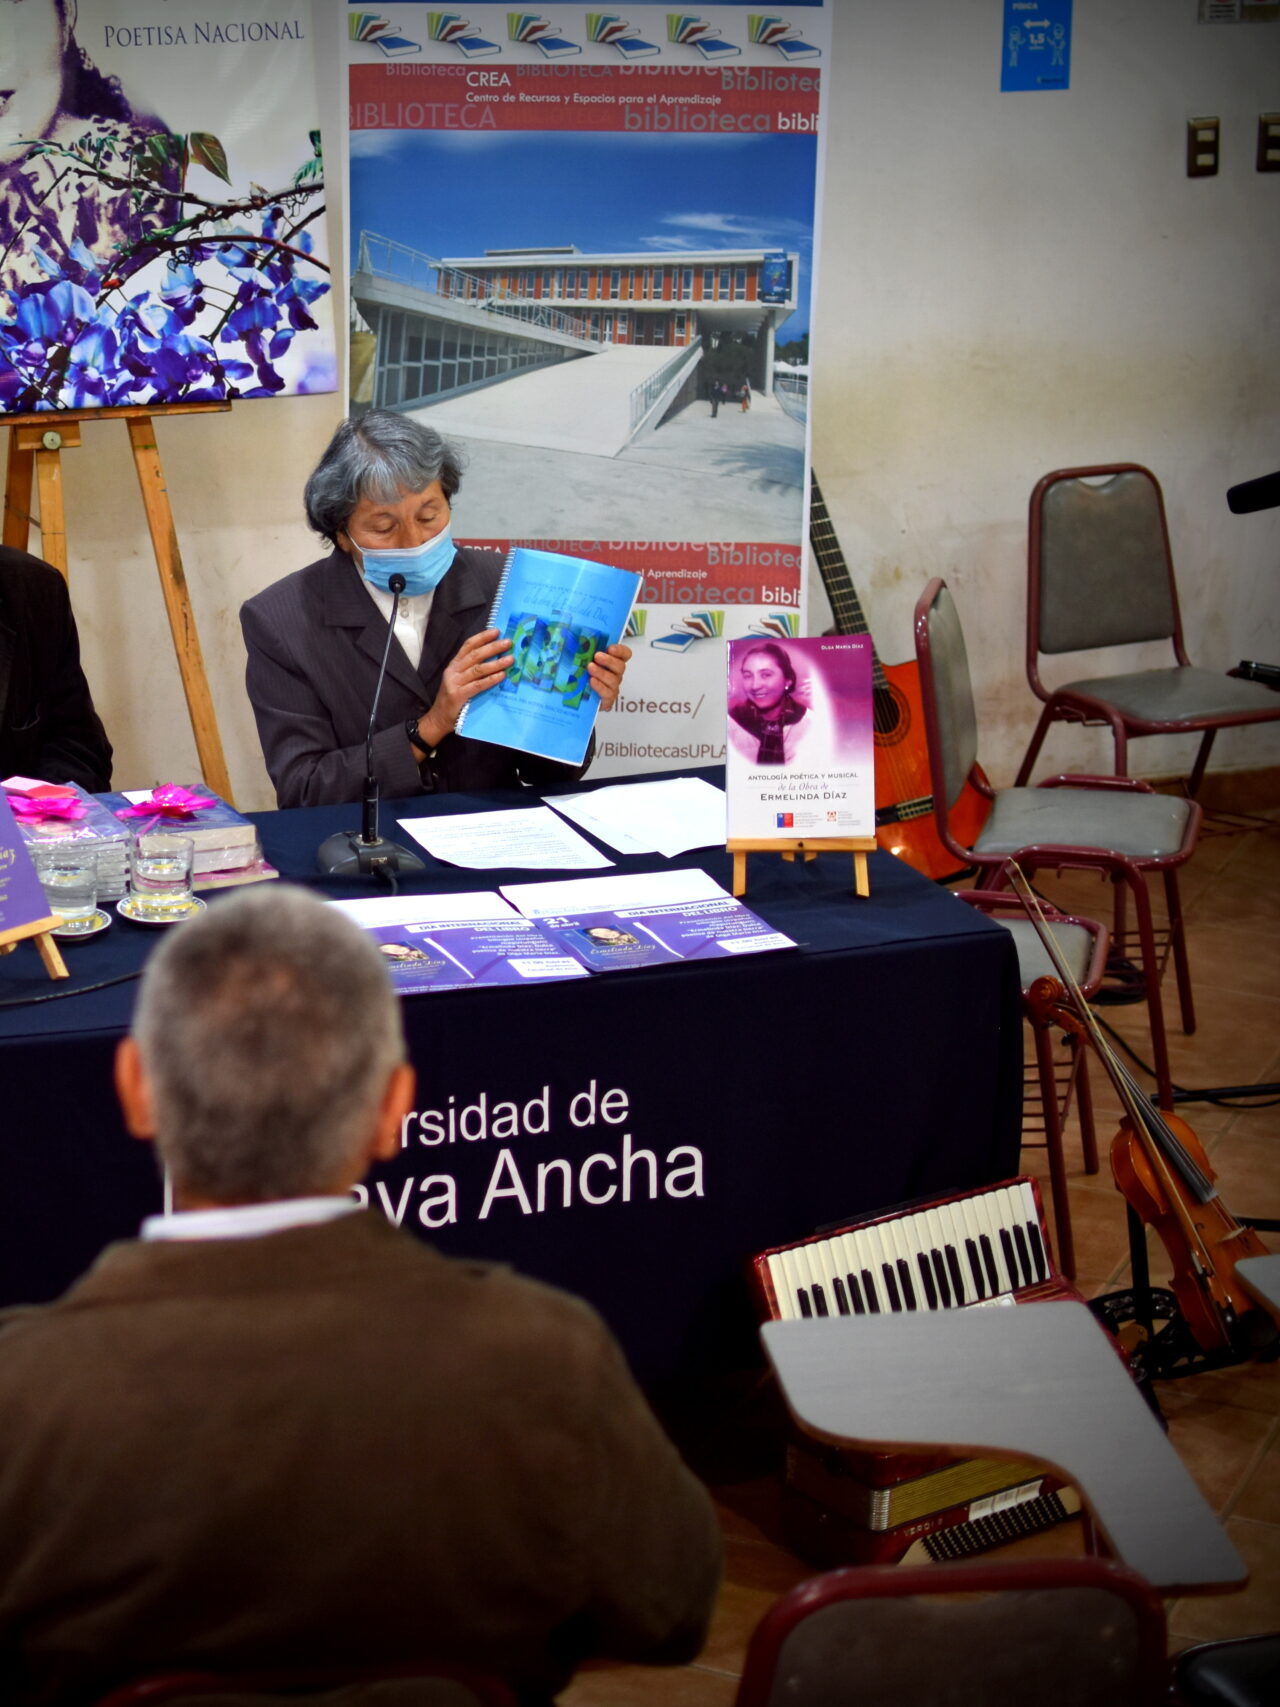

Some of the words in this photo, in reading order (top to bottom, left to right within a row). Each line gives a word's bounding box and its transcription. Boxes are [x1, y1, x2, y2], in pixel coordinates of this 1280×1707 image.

[104, 25, 188, 47] POETISA
[194, 20, 305, 44] NACIONAL
[466, 71, 511, 87] CREA
[466, 92, 500, 103] Centro
[503, 92, 516, 102] de
[520, 92, 561, 103] Recursos
[564, 95, 570, 105] y
[573, 93, 616, 105] Espacios
[618, 96, 644, 107] para
[646, 94, 657, 104] el
[659, 94, 722, 106] Aprendizaje
[349, 102, 497, 129] IBLIOTECA
[624, 104, 771, 131] biblioteca
[647, 568, 708, 580] Aprendizaje
[748, 773, 788, 781] ANTOLOGÍA
[777, 783, 787, 791] de
[788, 782, 796, 791] la
[798, 782, 818, 791] Obra
[760, 793, 820, 801] ERMELINDA
[823, 790, 848, 800] DÍAZ
[401, 1086, 550, 1148] rsidad
[569, 1080, 629, 1127] de
[478, 1134, 705, 1220] Ancha
